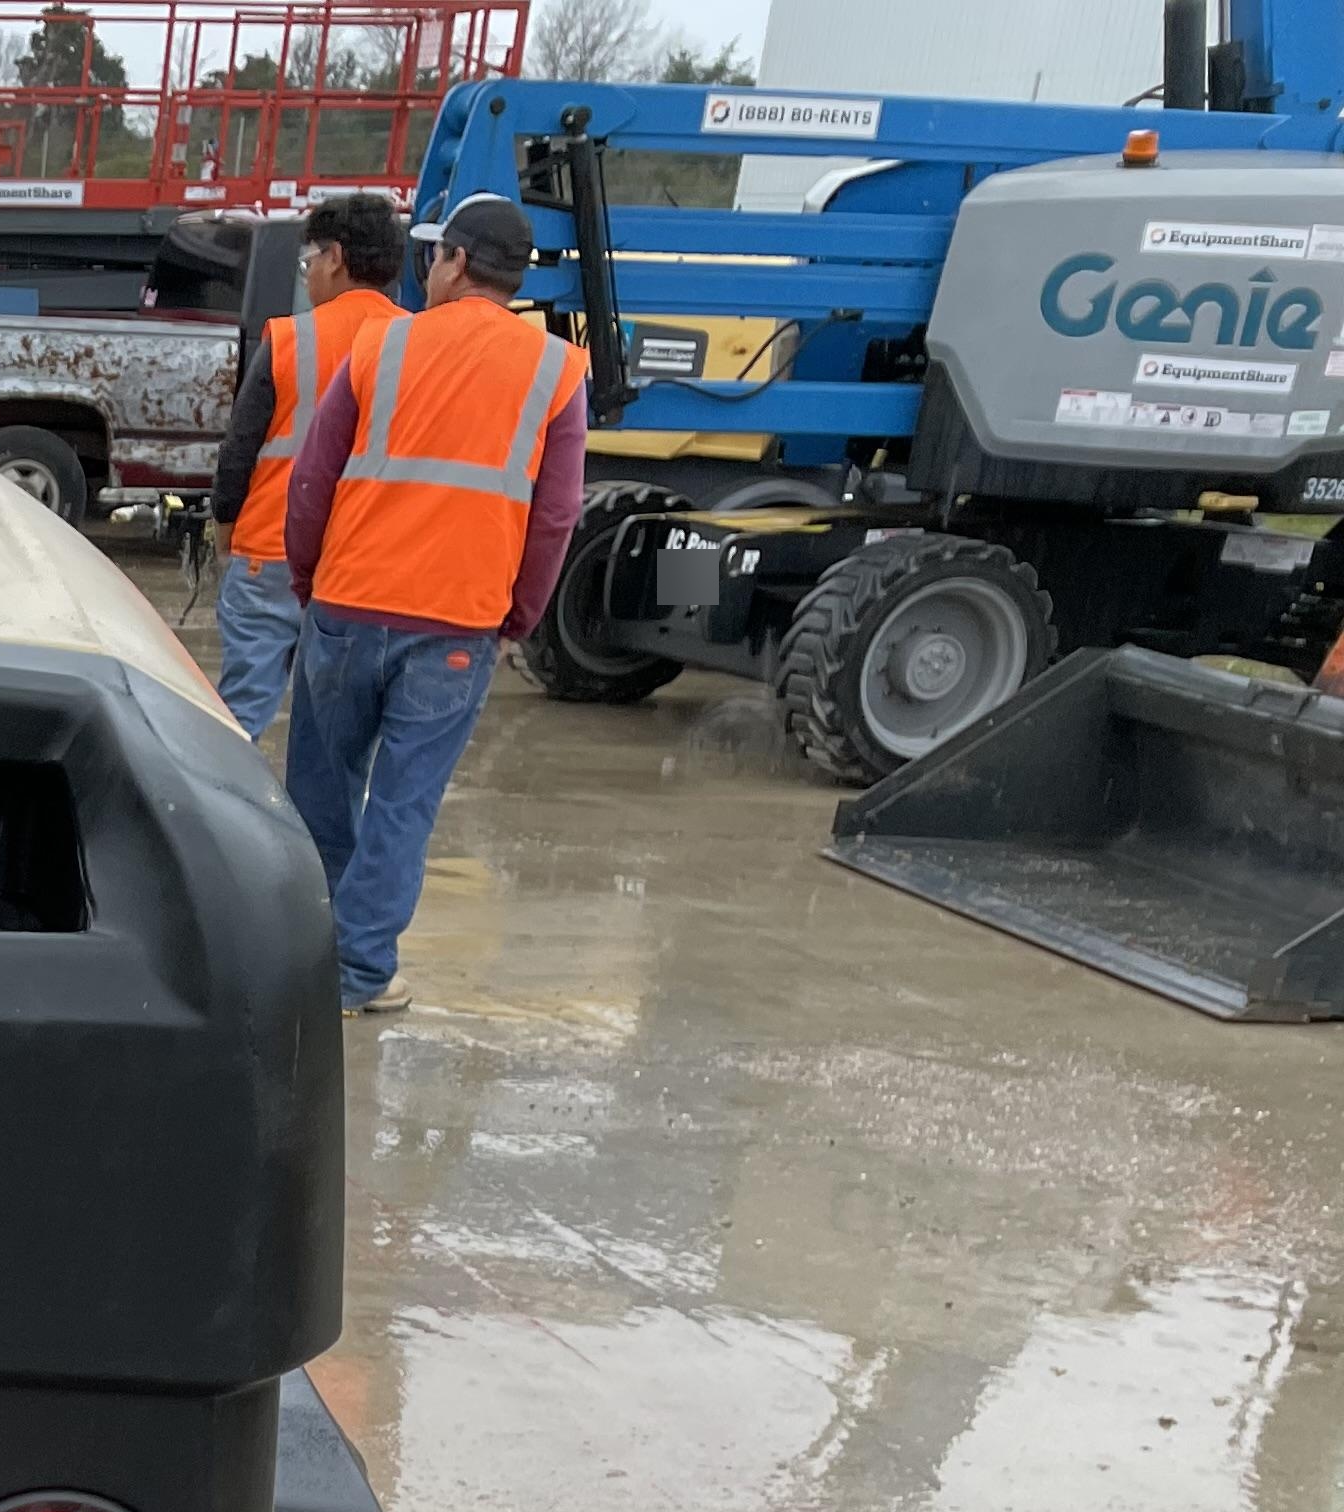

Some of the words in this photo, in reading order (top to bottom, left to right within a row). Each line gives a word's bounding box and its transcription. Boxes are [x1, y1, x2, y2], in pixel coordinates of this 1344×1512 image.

[1169, 230, 1304, 250] EquipmentShare
[1040, 252, 1323, 350] Genie
[1162, 363, 1287, 384] EquipmentShare
